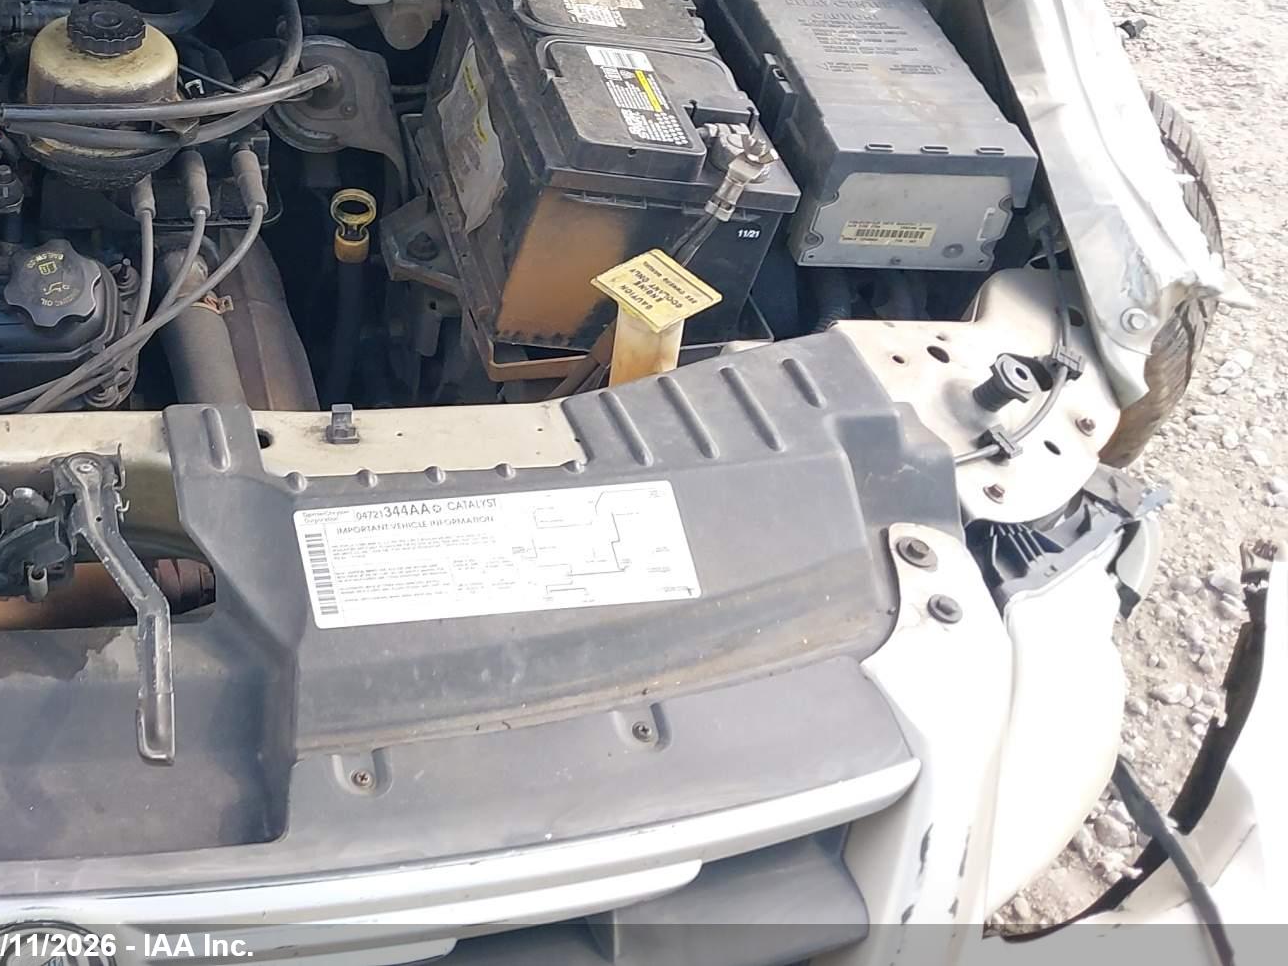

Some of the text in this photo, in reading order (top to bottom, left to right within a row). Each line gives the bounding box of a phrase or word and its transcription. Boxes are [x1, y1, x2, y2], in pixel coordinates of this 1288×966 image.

[737, 229, 761, 239] 11/21
[629, 268, 683, 308] COOLANT ONLY
[634, 280, 664, 302] ENGINE
[40, 298, 54, 307] OIL
[619, 285, 653, 310] CAUTION
[446, 498, 498, 511] CATALYST
[336, 516, 495, 534] IMPORTANT VEHICLE INFORMATION
